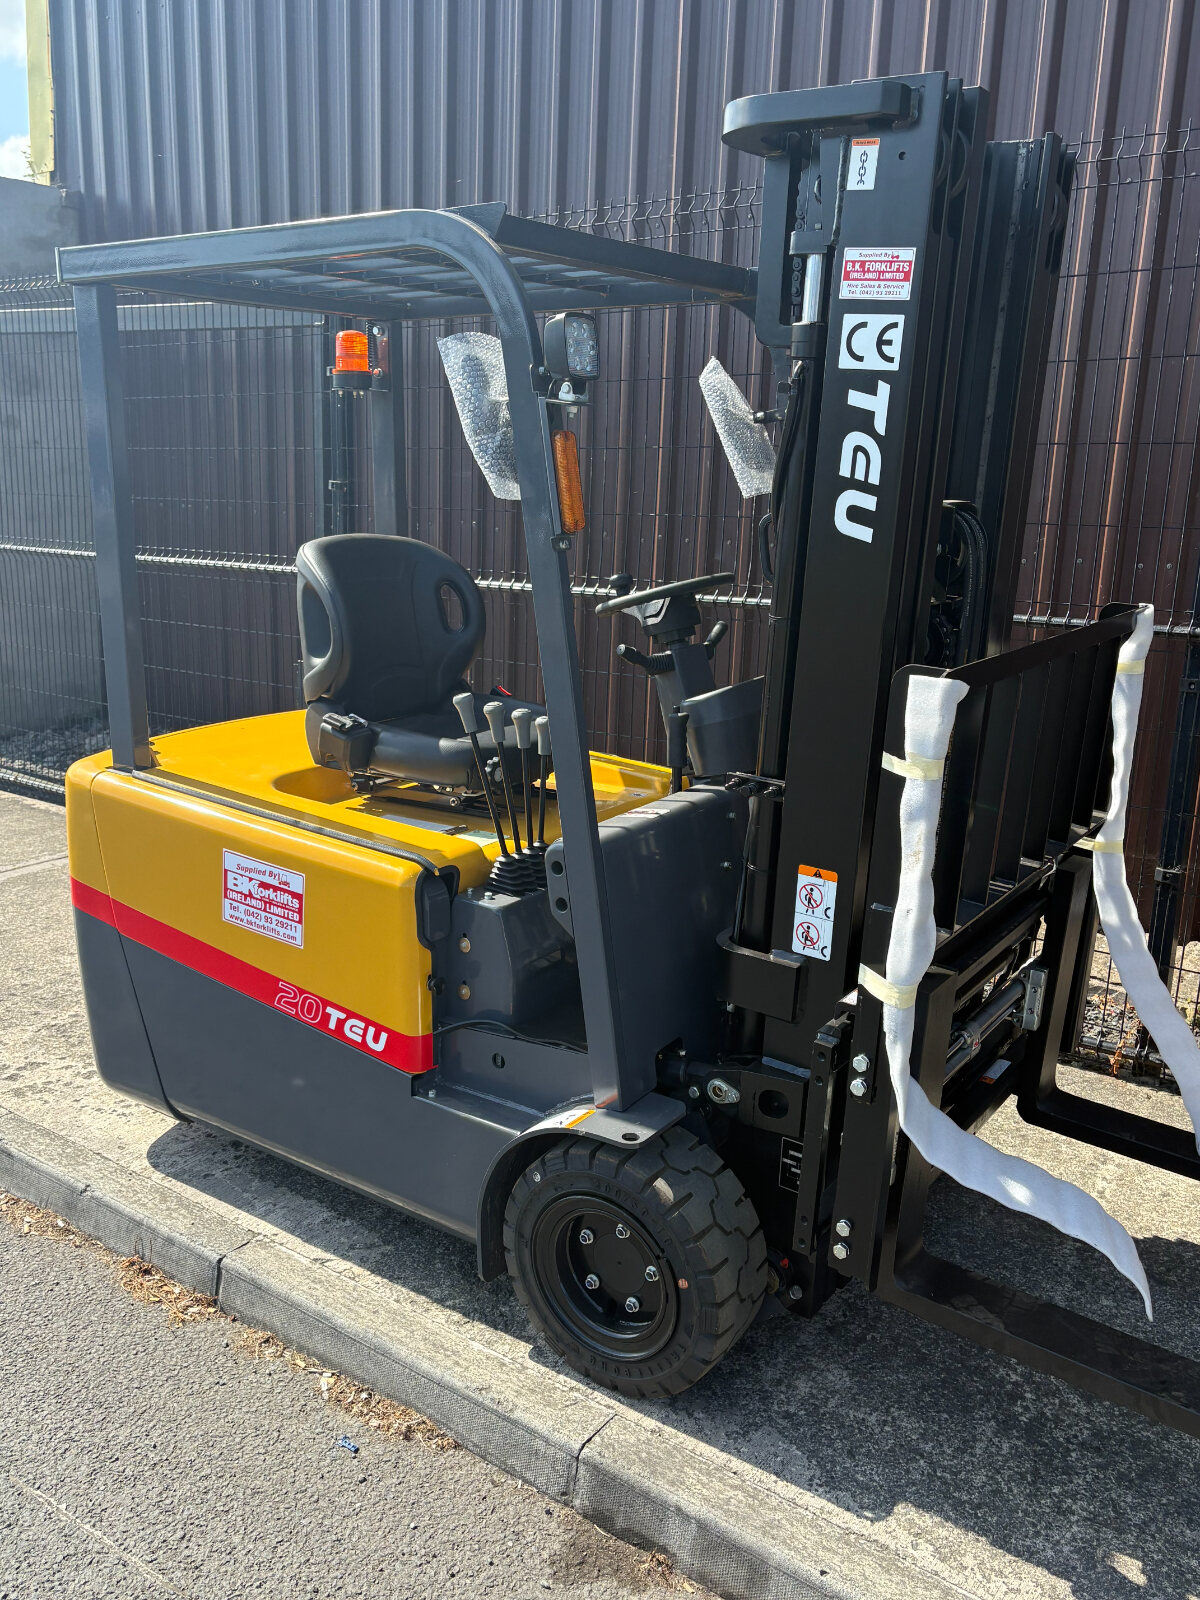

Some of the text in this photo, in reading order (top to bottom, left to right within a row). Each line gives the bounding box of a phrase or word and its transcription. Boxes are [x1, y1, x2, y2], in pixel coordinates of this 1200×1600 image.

[847, 262, 909, 271] B.K. FORKLIFTS
[834, 380, 890, 543] TEU
[236, 863, 278, 880] Supplied By
[227, 889, 264, 910] (IRELAND)
[266, 902, 299, 921] LIMITED
[229, 903, 297, 933] Tel. (042) 93 29211
[228, 913, 297, 942] www.bkforklifts.com
